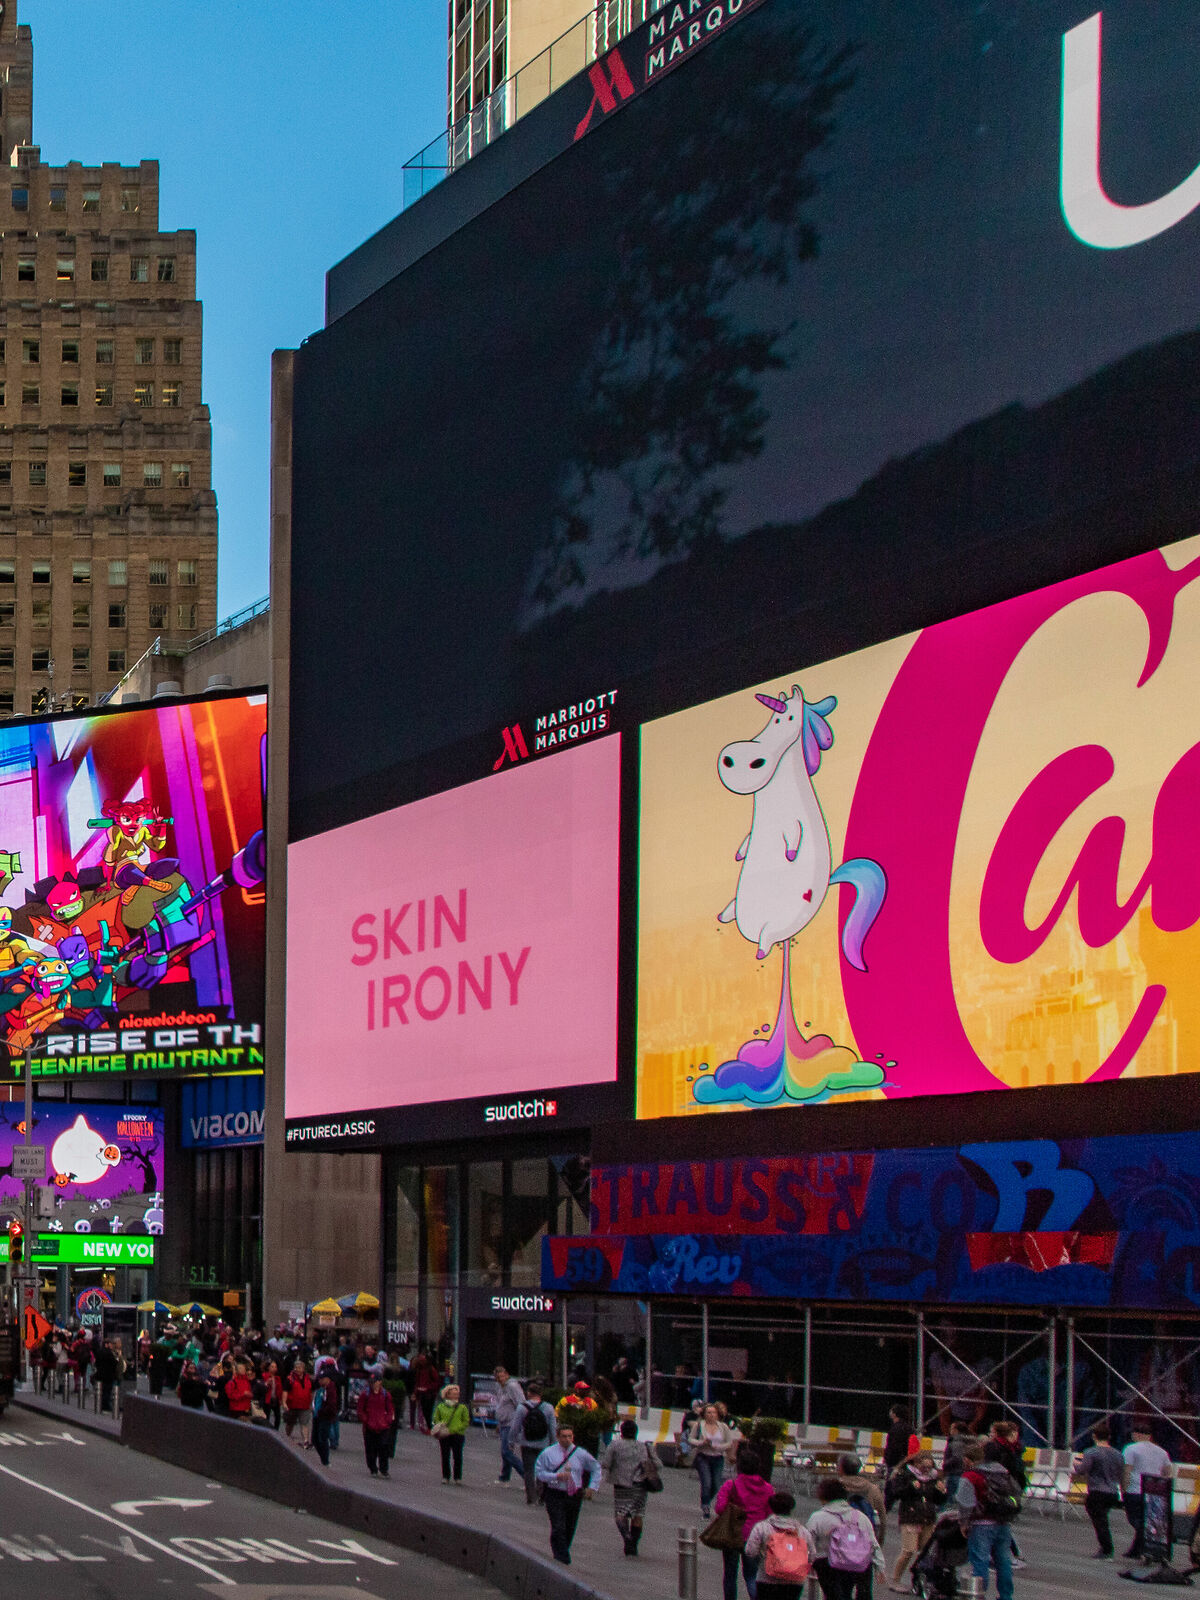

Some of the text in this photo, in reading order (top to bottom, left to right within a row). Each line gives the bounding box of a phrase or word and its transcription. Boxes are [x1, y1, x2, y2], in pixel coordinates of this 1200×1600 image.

[536, 690, 618, 731] MARRIOTT
[535, 713, 608, 752] MARQUIS
[838, 540, 1200, 1098] Ca
[350, 888, 467, 967] SKIN
[367, 946, 532, 1031] IRONY
[119, 1011, 217, 1029] nickelodeon
[46, 1030, 148, 1056] RISE
[153, 1028, 200, 1048] OF
[10, 1053, 127, 1077] TEENAGE
[133, 1048, 245, 1071] MUTANT
[485, 1100, 545, 1122] swatch
[117, 1121, 154, 1137] HALLOWEEN
[287, 1120, 375, 1142] #FUTURECLASSIC
[83, 1242, 125, 1257] NEW
[491, 1295, 544, 1312] swatch
[387, 1320, 415, 1333] THINK
[387, 1332, 408, 1344] FUN
[170, 1537, 400, 1566] ONLY
